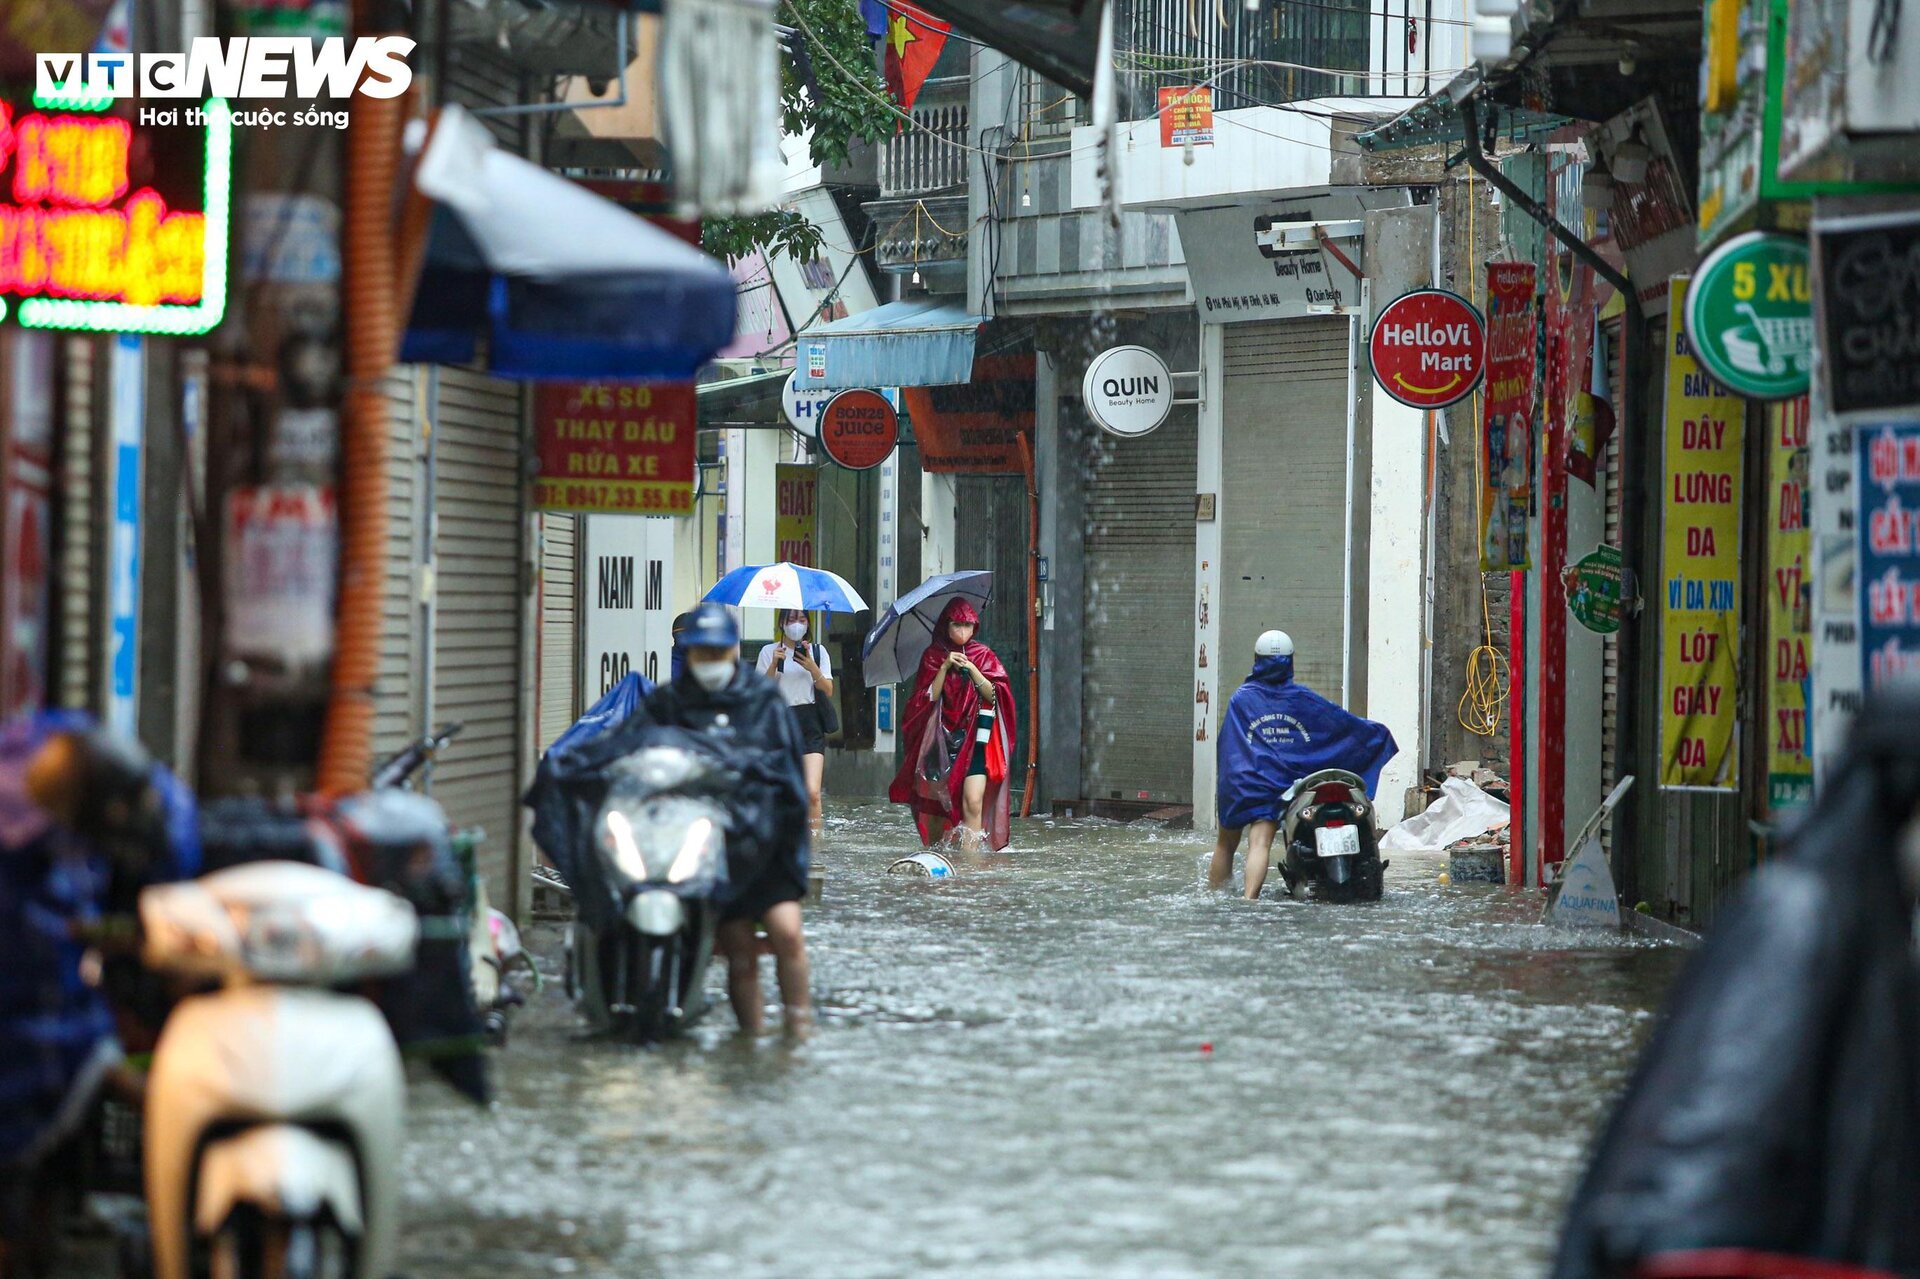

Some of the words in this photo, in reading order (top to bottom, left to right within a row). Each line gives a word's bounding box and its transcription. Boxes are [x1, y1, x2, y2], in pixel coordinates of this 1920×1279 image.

[1274, 259, 1299, 280] Beauty
[1300, 259, 1321, 273] Home
[1732, 262, 1756, 301] 5
[1383, 322, 1472, 346] HelloVi
[1421, 352, 1472, 371] Mart
[1102, 376, 1159, 397] QUIN
[555, 418, 616, 440] THAY
[1682, 413, 1726, 450] DÂY
[627, 455, 659, 476] XE
[1674, 470, 1732, 503] LƯNG
[1779, 481, 1802, 531] DA
[1687, 526, 1716, 557] DA
[599, 556, 633, 609] NAM
[1776, 552, 1803, 609] VÍ
[1686, 579, 1704, 610] DA
[1709, 579, 1733, 617] XỊN
[1680, 627, 1719, 663] LÓT
[1777, 637, 1808, 679] DA
[1560, 894, 1616, 913] AQUAFINA
